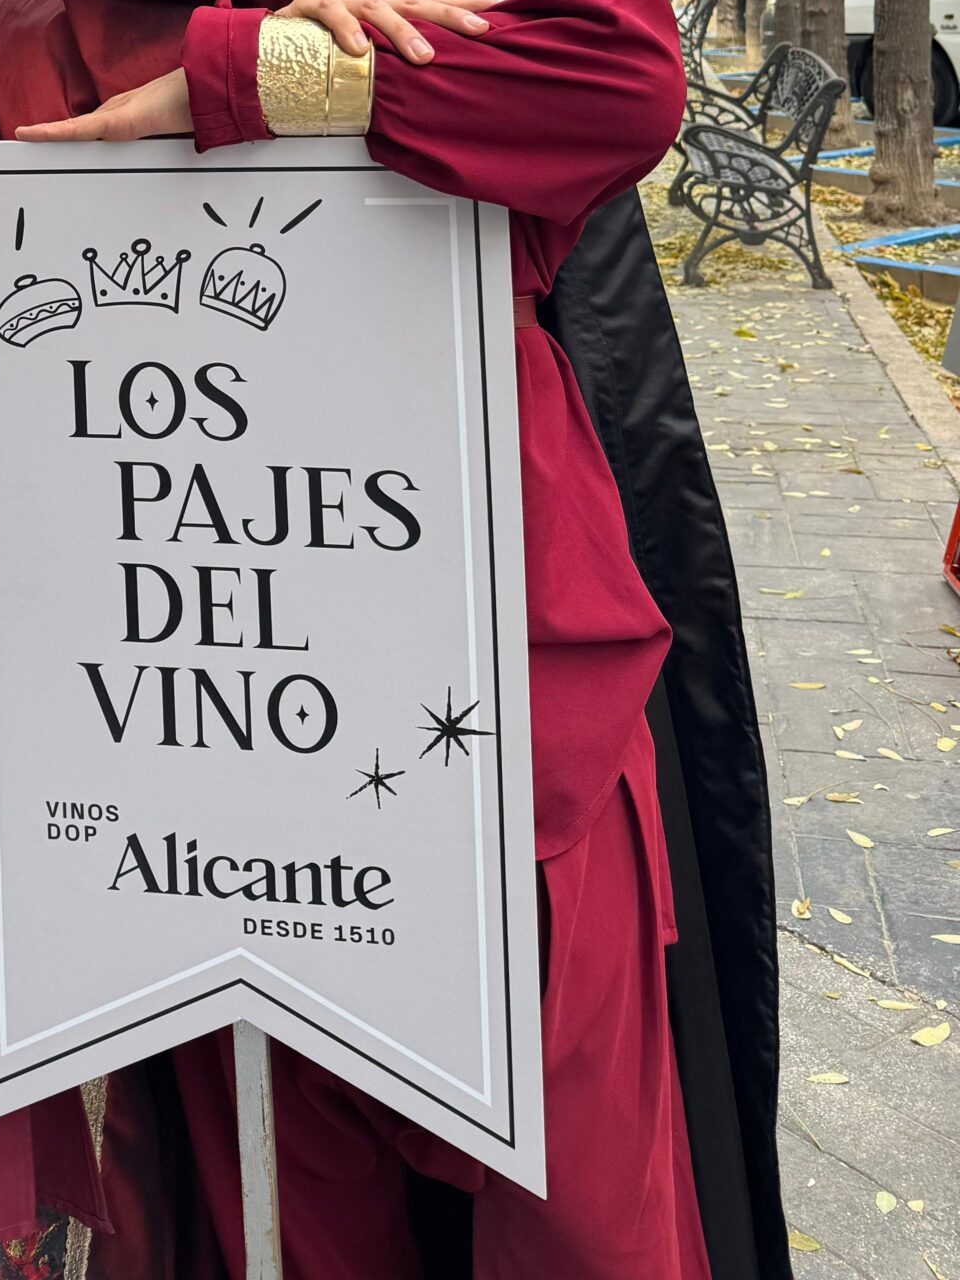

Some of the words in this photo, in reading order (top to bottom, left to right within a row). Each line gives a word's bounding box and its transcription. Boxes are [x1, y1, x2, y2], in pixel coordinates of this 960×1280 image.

[66, 359, 249, 442] LOS
[113, 460, 422, 552] PAJES
[117, 562, 310, 652] DEL
[77, 662, 339, 754] VINO
[45, 800, 120, 823] VINOS
[46, 822, 98, 842] DOP
[107, 831, 395, 911] Alicante
[243, 917, 324, 940] DESDE
[333, 924, 396, 946] 1510
